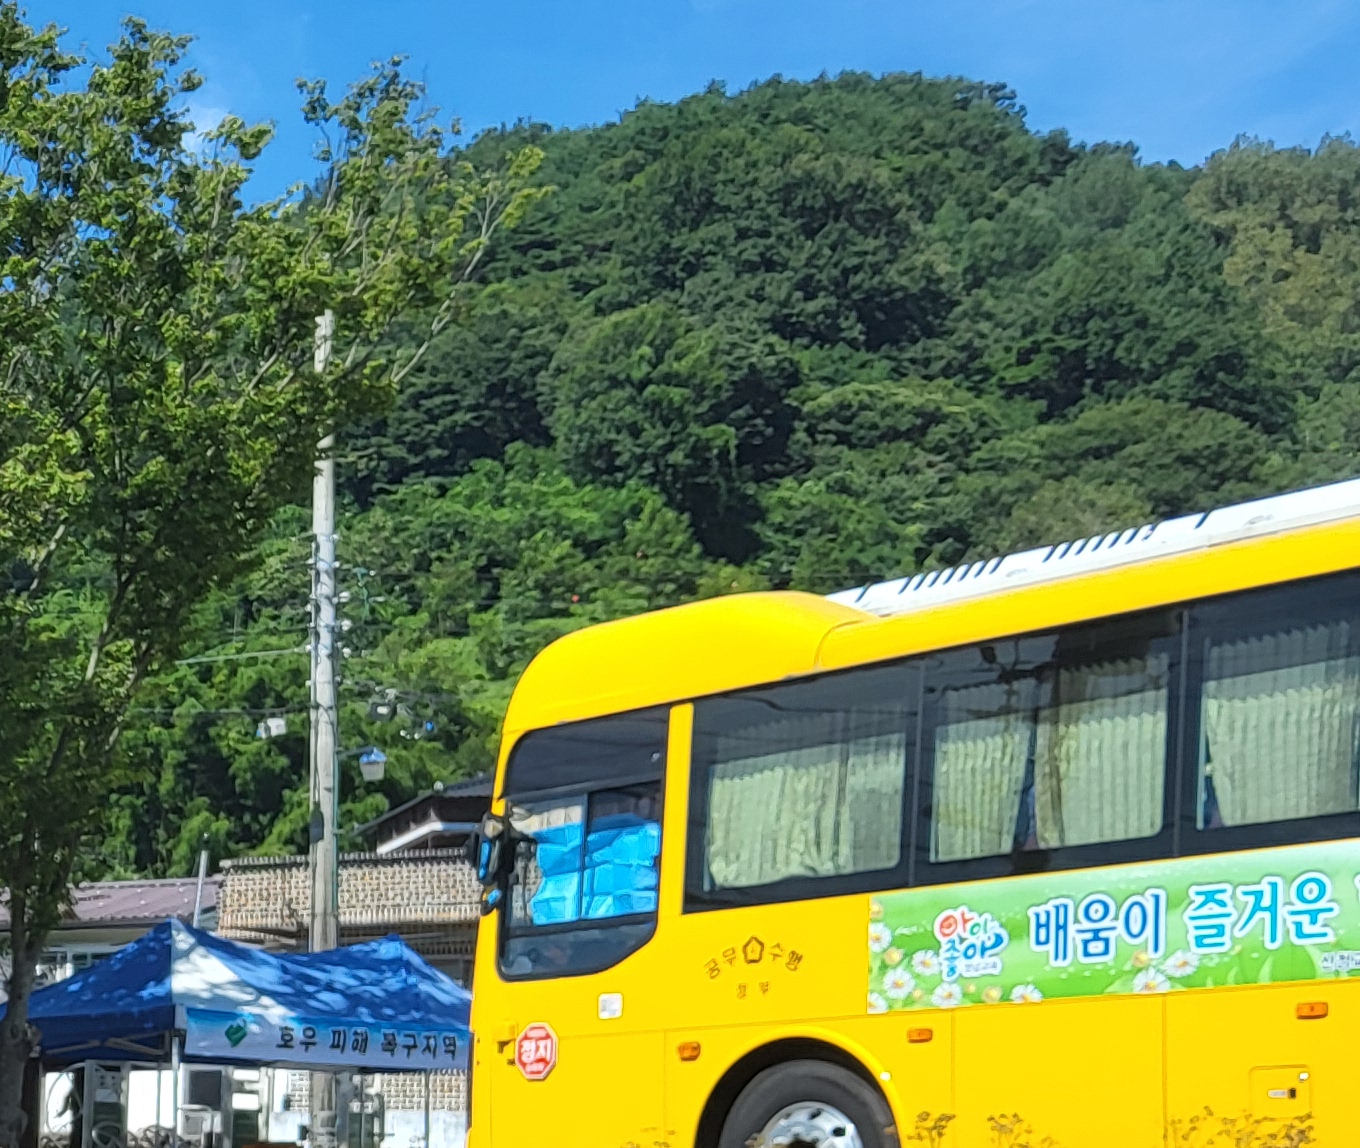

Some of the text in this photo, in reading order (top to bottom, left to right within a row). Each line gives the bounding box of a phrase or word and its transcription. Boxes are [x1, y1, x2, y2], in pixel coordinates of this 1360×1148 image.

[1032, 876, 1336, 962] 배움이 즐거운
[275, 1026, 318, 1053] 호우
[329, 1028, 369, 1055] 피해
[520, 1039, 552, 1064] 정지
